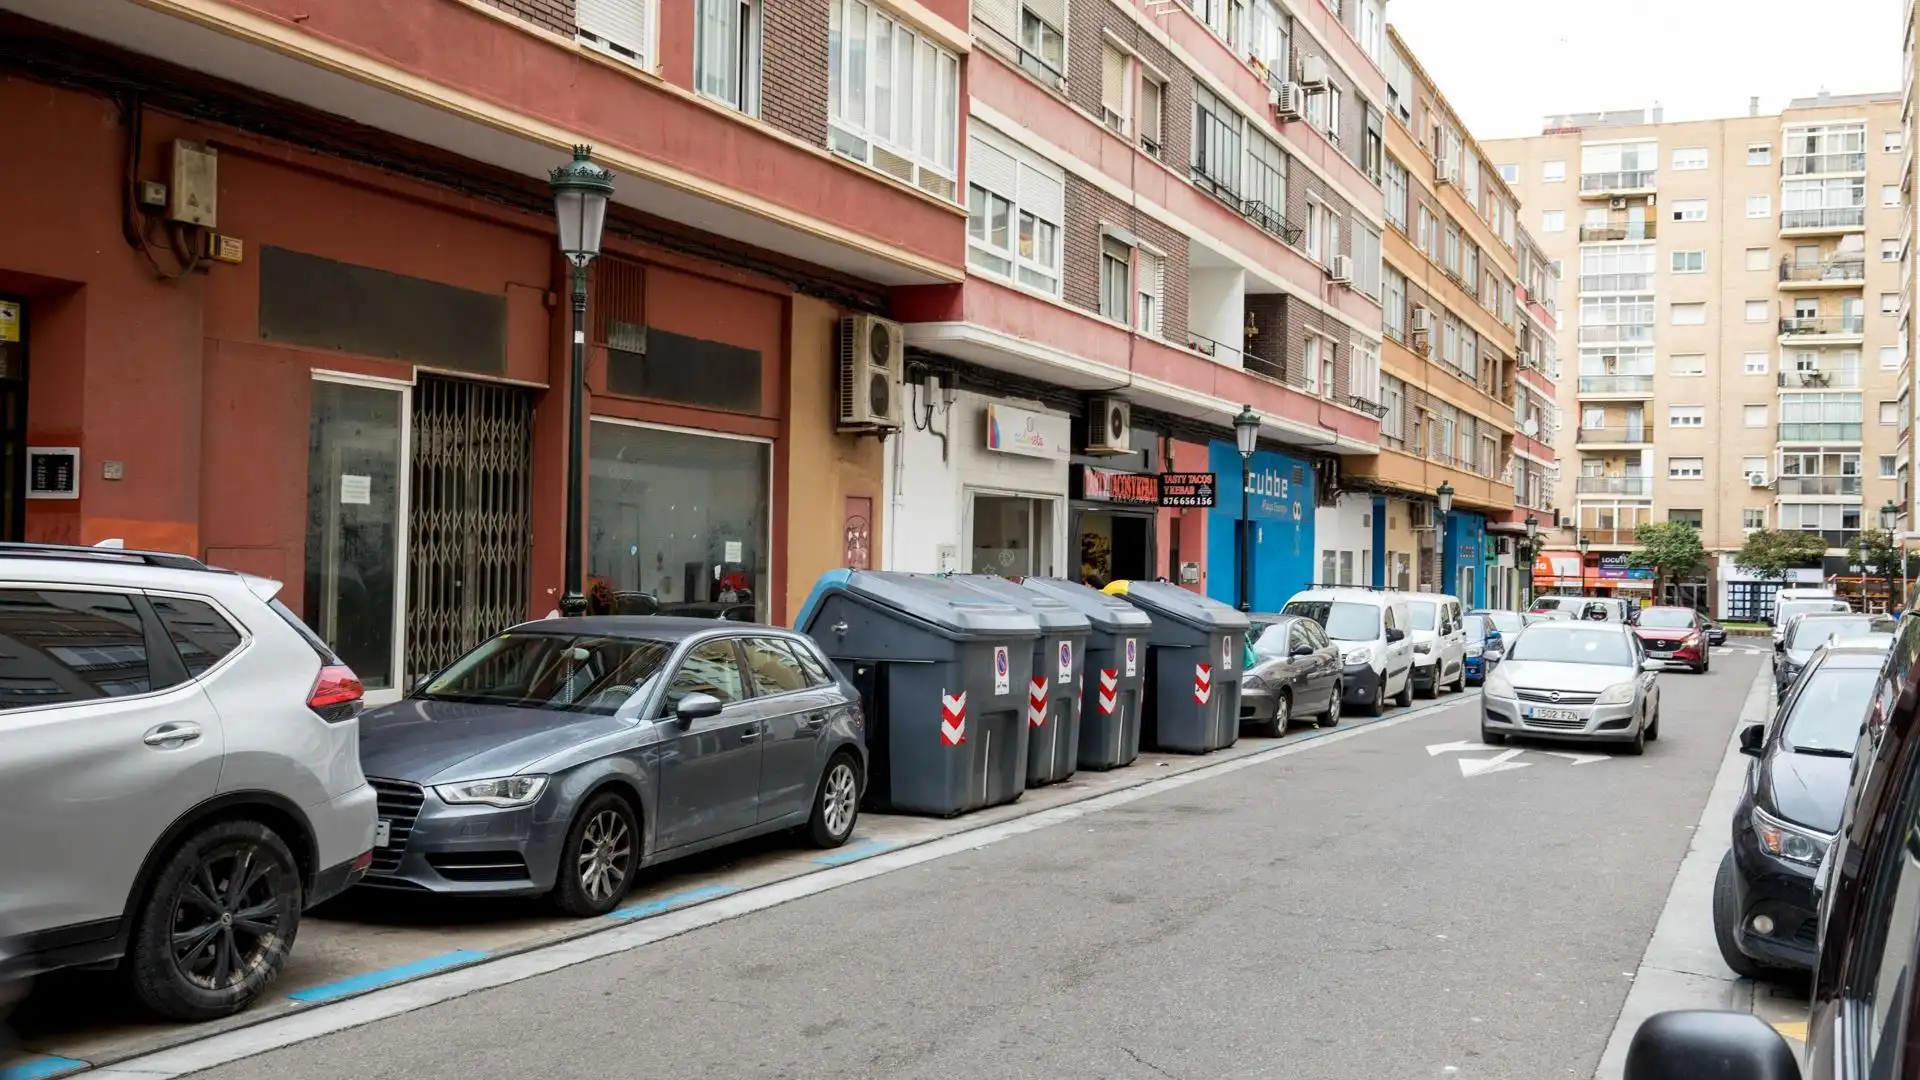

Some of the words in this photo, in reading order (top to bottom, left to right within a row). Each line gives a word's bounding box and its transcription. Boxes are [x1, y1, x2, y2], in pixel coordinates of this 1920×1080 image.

[1163, 474, 1186, 484] TASTY
[1188, 474, 1212, 484] TACOS
[1170, 485, 1195, 495] KEBAB
[1163, 497, 1179, 505] 876
[1180, 497, 1195, 505] 656
[1197, 497, 1212, 505] 156
[1538, 708, 1557, 719] 1502
[1561, 711, 1578, 720] FZN
